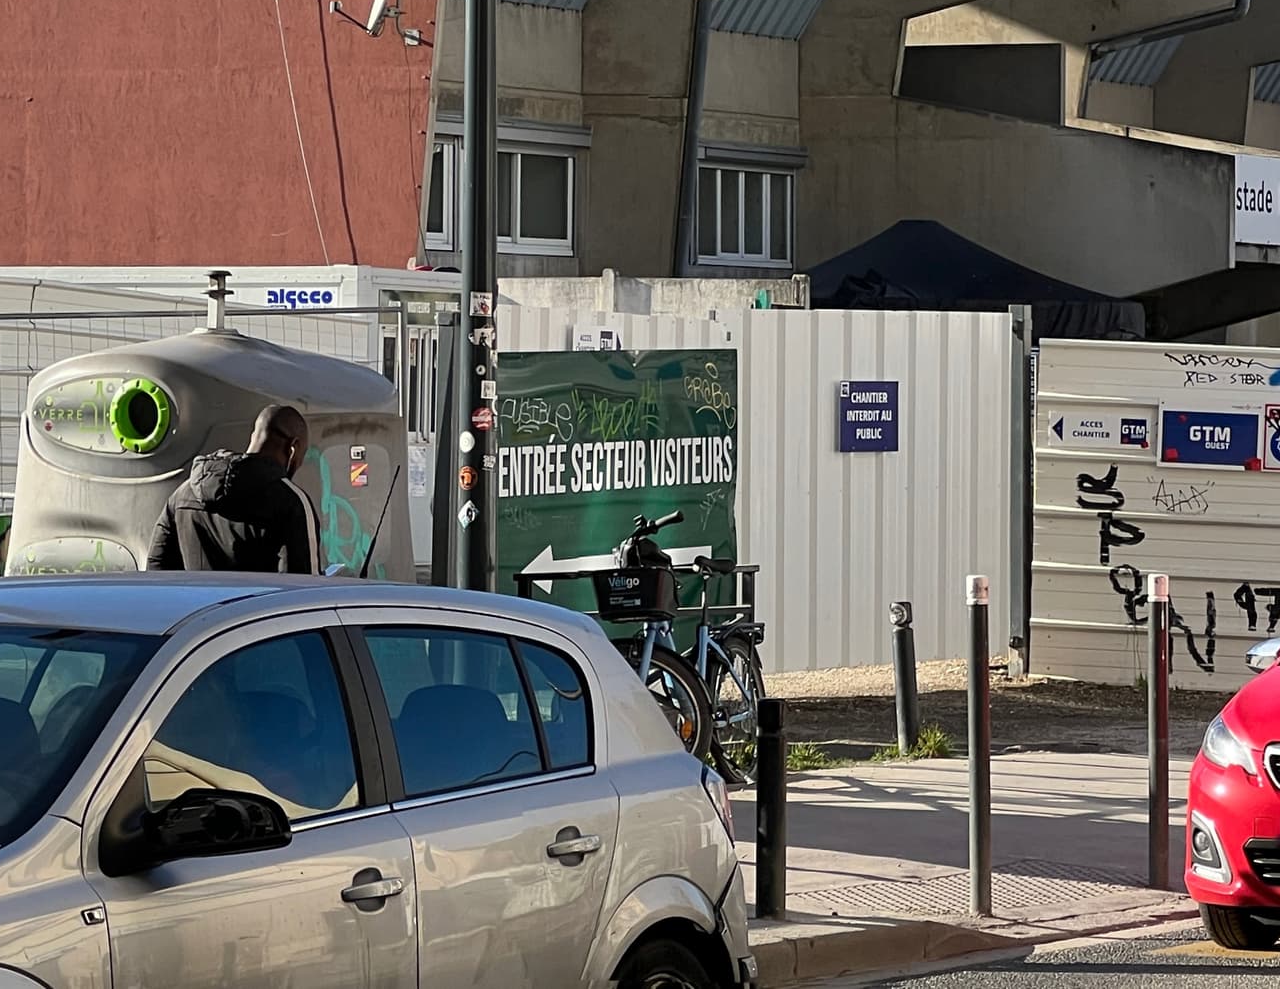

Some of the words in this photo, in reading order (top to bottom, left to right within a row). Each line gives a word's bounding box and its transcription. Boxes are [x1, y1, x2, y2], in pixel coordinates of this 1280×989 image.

[1236, 180, 1273, 213] stade
[267, 289, 333, 309] algeco
[850, 392, 888, 403] CHANTIER
[39, 408, 84, 420] VERRE
[846, 409, 880, 421] INTERDIT
[880, 410, 892, 421] AU
[1080, 420, 1103, 428] ACCES
[1121, 425, 1146, 435] GTM
[855, 428, 882, 439] PUBLIC
[1072, 430, 1110, 438] CHANTIER
[1189, 425, 1231, 443] GTM
[1205, 441, 1230, 449] OUEST
[498, 434, 567, 498] ENTRÉE
[571, 440, 646, 493] SECTEUR
[650, 435, 733, 487] VISITEURS
[608, 574, 640, 589] Véligo
